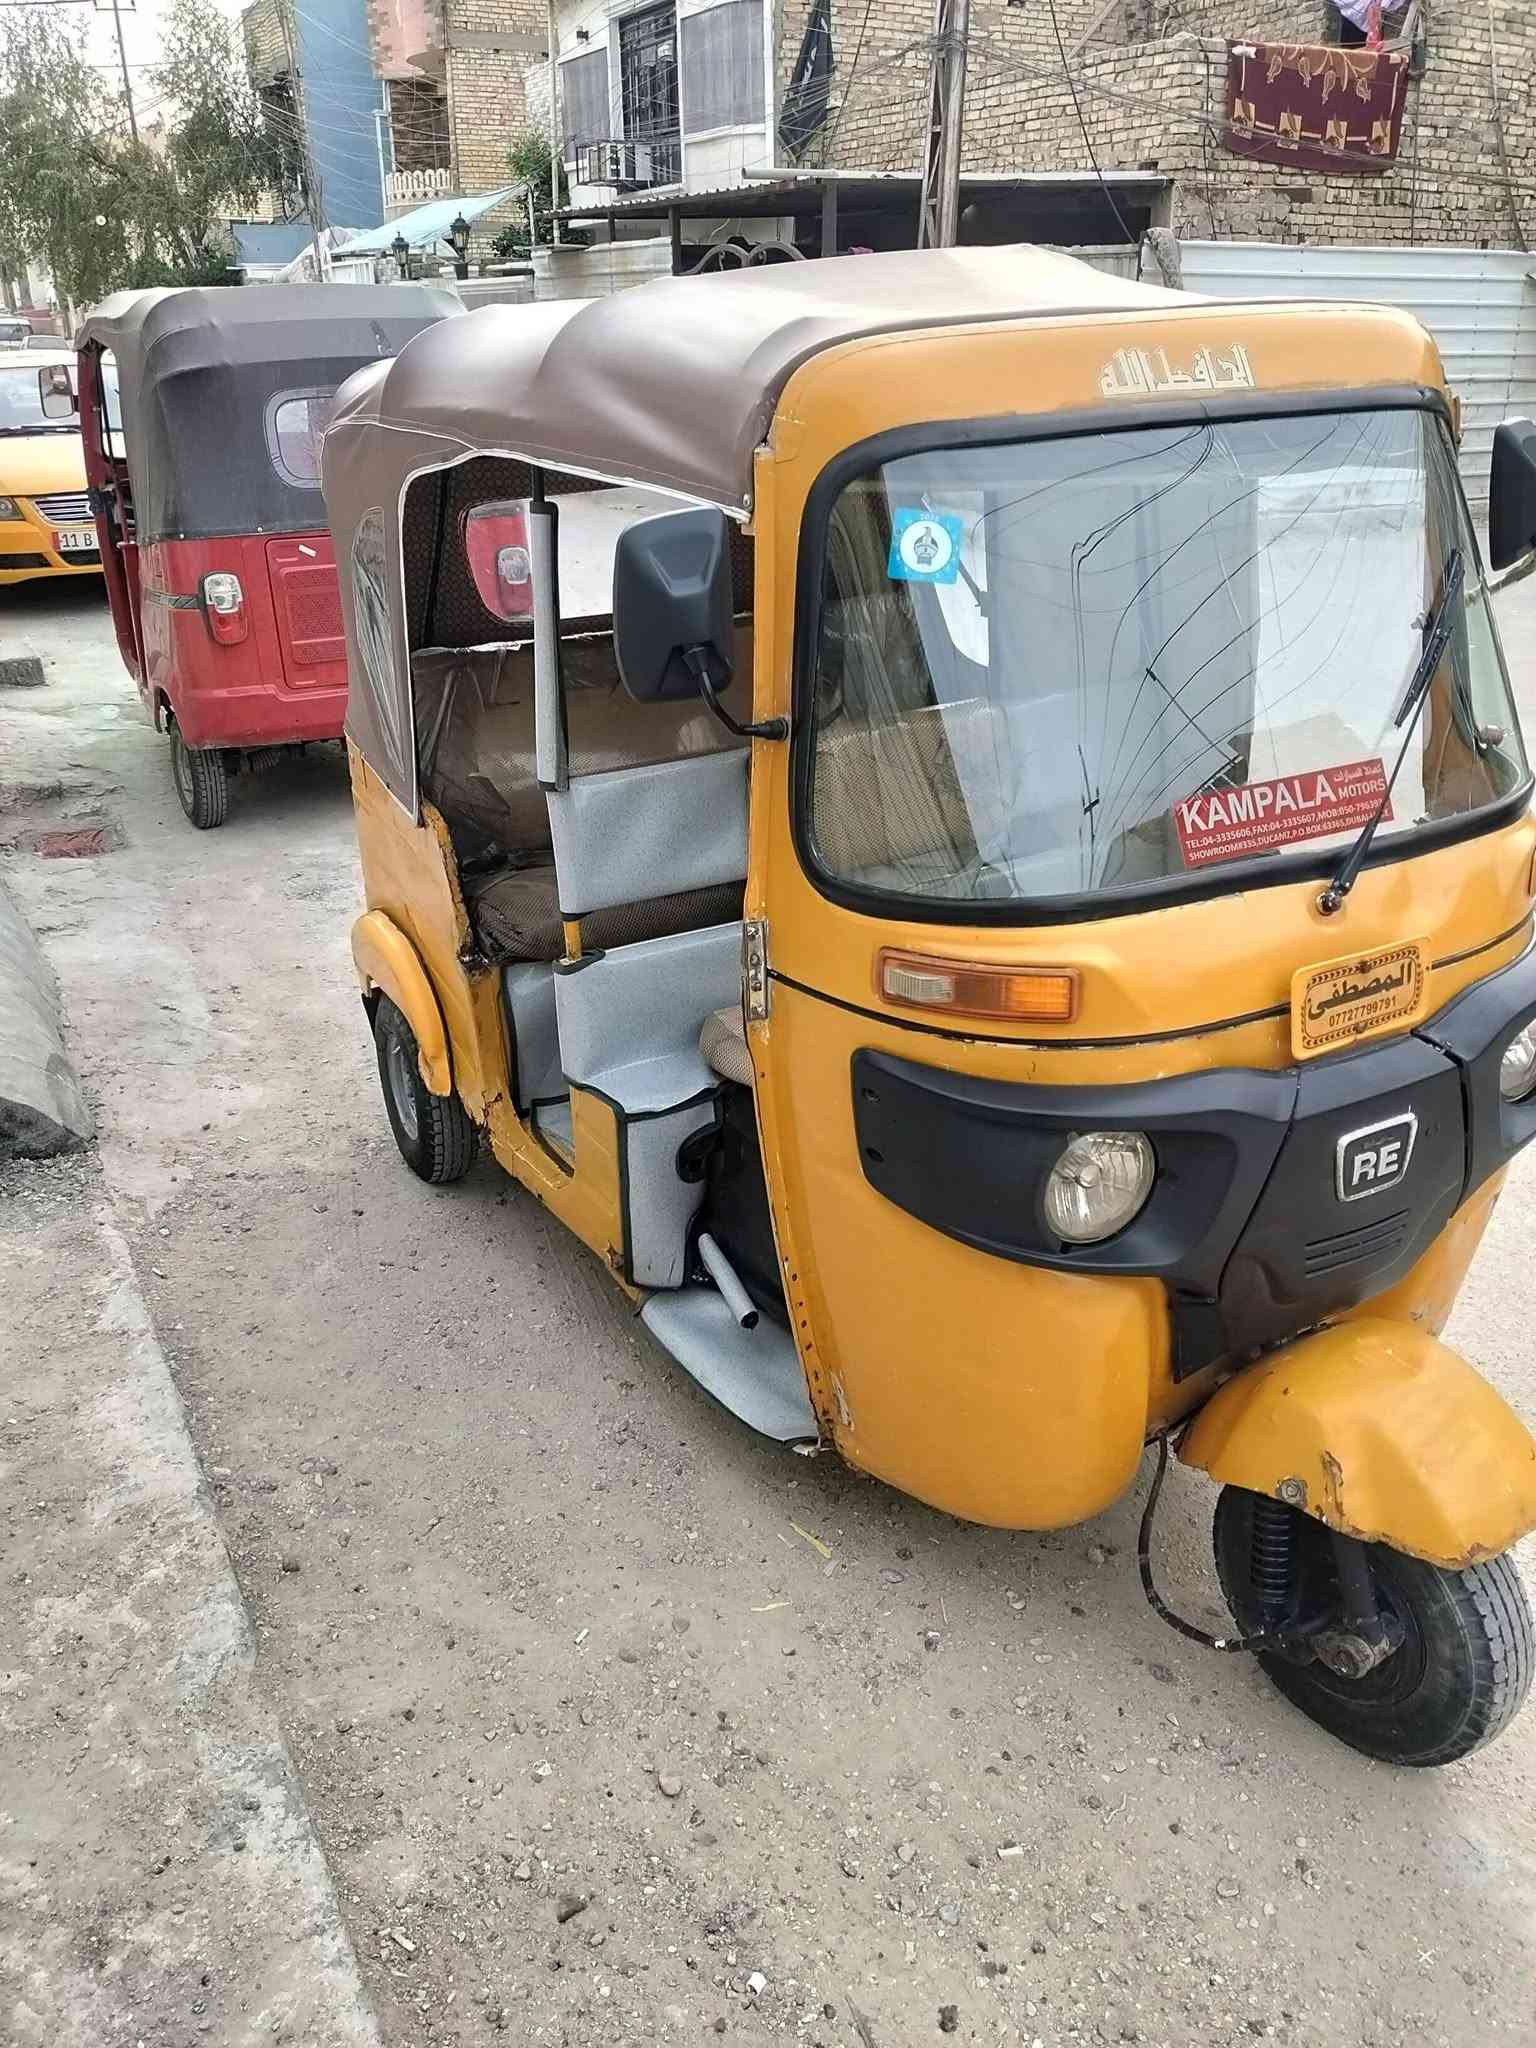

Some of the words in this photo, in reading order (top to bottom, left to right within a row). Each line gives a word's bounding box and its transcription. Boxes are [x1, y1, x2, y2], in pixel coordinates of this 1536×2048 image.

[1100, 348, 1153, 395] الله
[62, 534, 79, 548] 11
[84, 533, 94, 547] B
[1182, 774, 1337, 834] KAMPALA
[1338, 779, 1386, 800] MOTORS
[1308, 959, 1412, 1020] المصطفى
[1328, 995, 1397, 1027] 07727799791
[1351, 1141, 1401, 1186] RE
